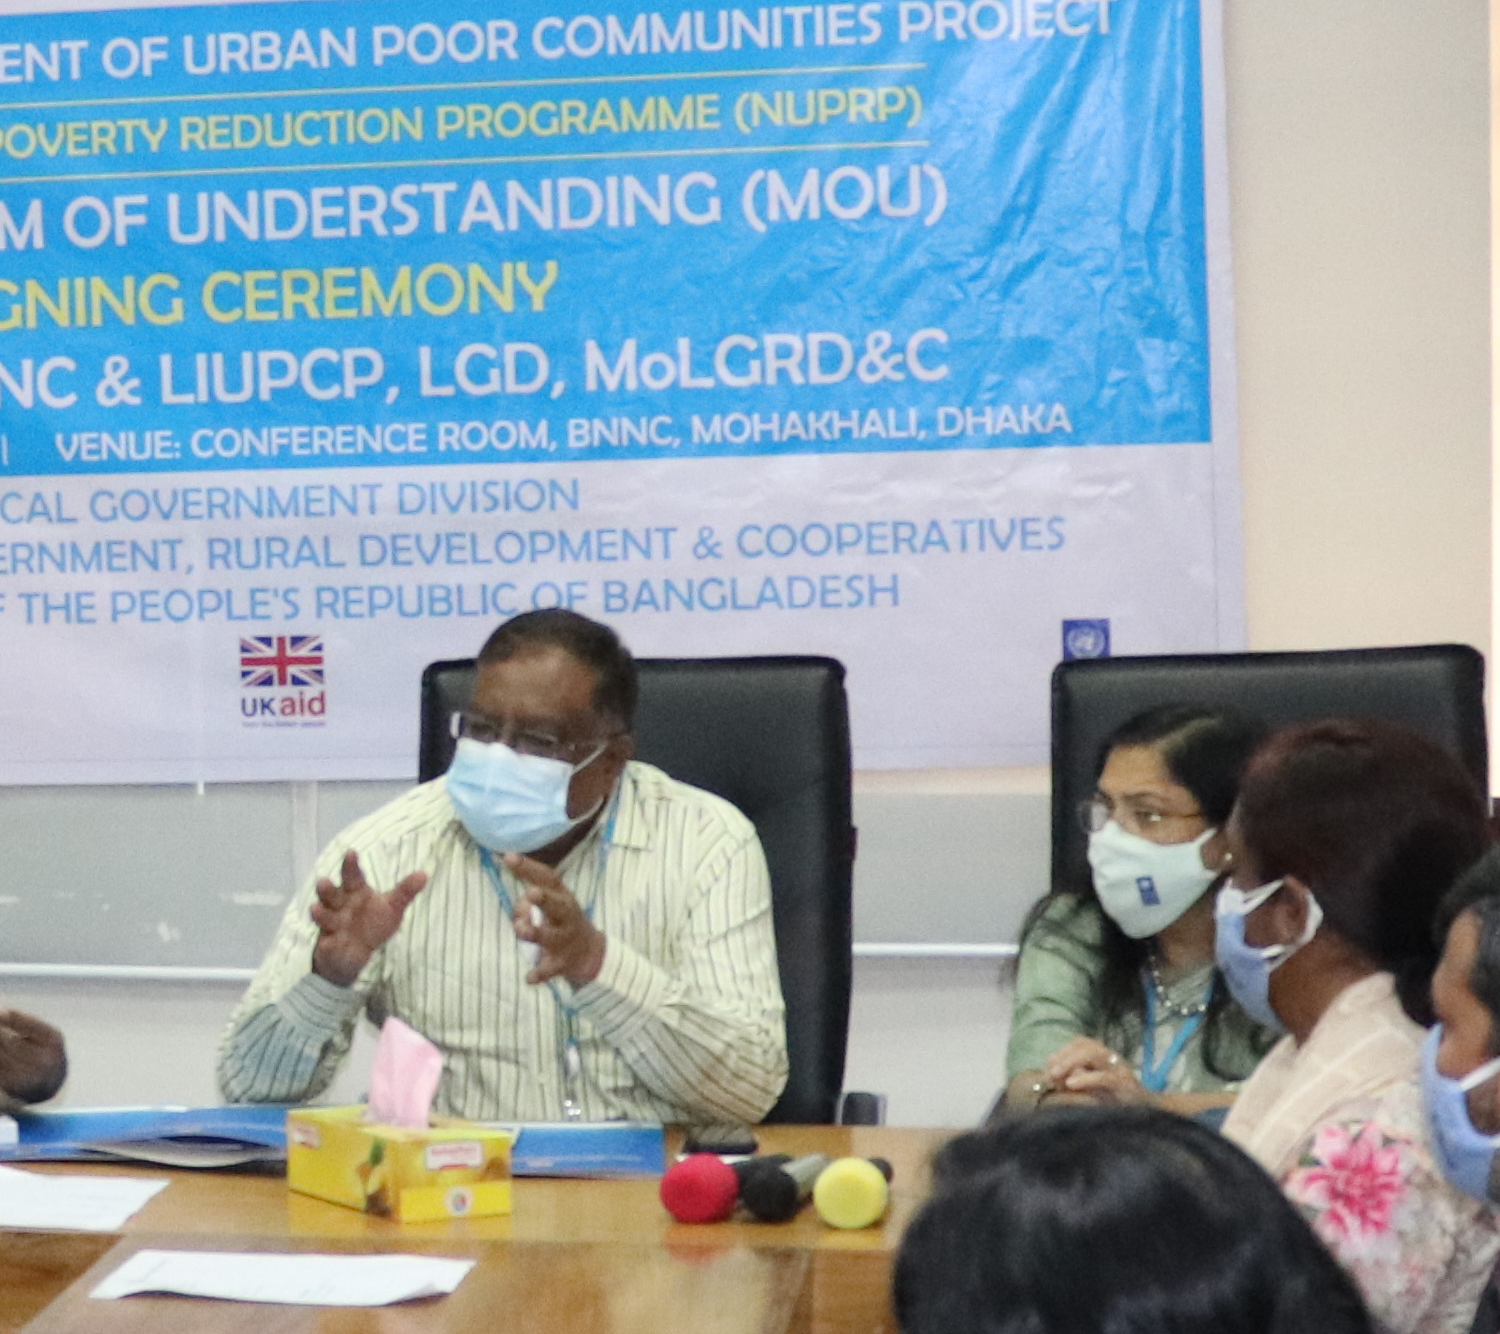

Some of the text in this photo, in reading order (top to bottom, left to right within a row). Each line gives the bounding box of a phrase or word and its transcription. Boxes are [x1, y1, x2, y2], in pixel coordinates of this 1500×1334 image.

[102, 36, 168, 78] OF
[182, 26, 357, 75] URBAN
[371, 18, 518, 66] POOR
[531, 2, 882, 58] COMMUNITIES
[180, 105, 424, 151] REDUCTION
[436, 93, 720, 138] PROGRAMME
[734, 86, 923, 134] (NUPRP)
[62, 193, 149, 247] OF
[166, 173, 721, 245] UNDERSTANDING
[741, 163, 949, 233] (MOU)
[202, 259, 559, 323] CEREMONY
[95, 354, 141, 407] &
[160, 346, 400, 405] LIUPCP,
[418, 342, 565, 399] LGD,
[584, 327, 949, 393] MoLGRD&C
[55, 430, 181, 463] VENUE:
[190, 423, 427, 459] CONFERENCE
[437, 419, 558, 454] ROOM,
[567, 415, 680, 450] BNNC,
[690, 407, 927, 445] MOHAKHALI,
[937, 401, 1073, 436] DHAKA
[88, 482, 383, 523] GOVERNMENT
[397, 478, 580, 516] DIVISION
[207, 534, 346, 570] RURAL
[358, 527, 679, 568] DEVELOPMENT
[692, 526, 722, 559] &
[736, 516, 1067, 557] COOPERATIVES
[18, 591, 97, 624] THE
[110, 586, 302, 624] PEOPLE'S
[314, 581, 518, 620] REPUBLIC
[531, 580, 588, 611] OF
[602, 574, 901, 614] BANGLADESH
